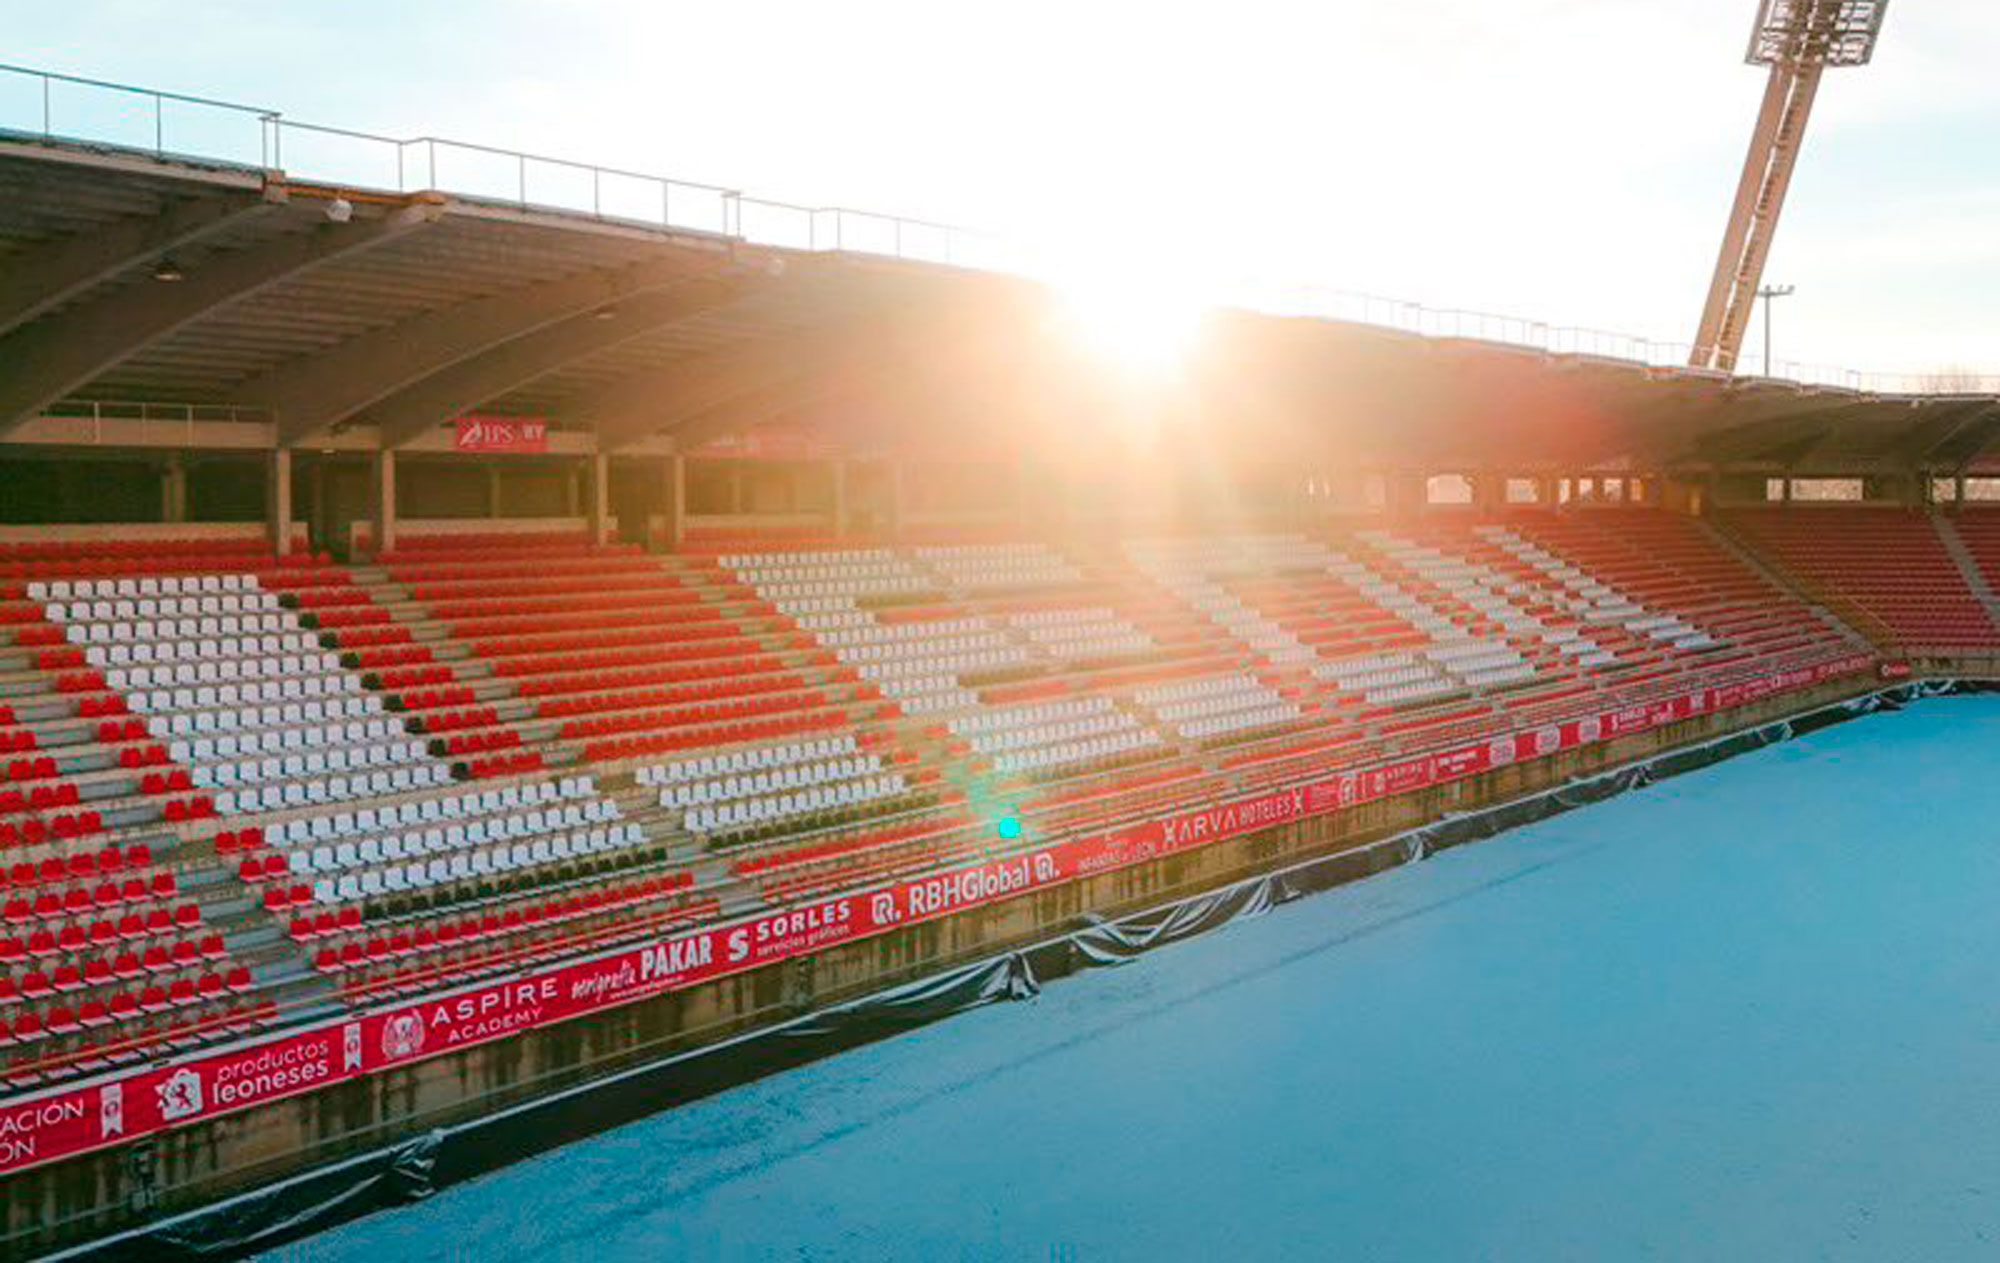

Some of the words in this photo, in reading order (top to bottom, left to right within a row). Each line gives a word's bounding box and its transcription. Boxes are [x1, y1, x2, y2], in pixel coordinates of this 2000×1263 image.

[909, 856, 1031, 917] RBHGlobal
[756, 899, 850, 942] SORLES
[641, 934, 713, 981] PAKAR
[431, 977, 559, 1028] ASPIRE
[447, 1007, 543, 1043] ACADEMY
[213, 1058, 329, 1105] leoneses
[217, 1040, 329, 1084] productos
[0, 1098, 84, 1138] ACIÓN
